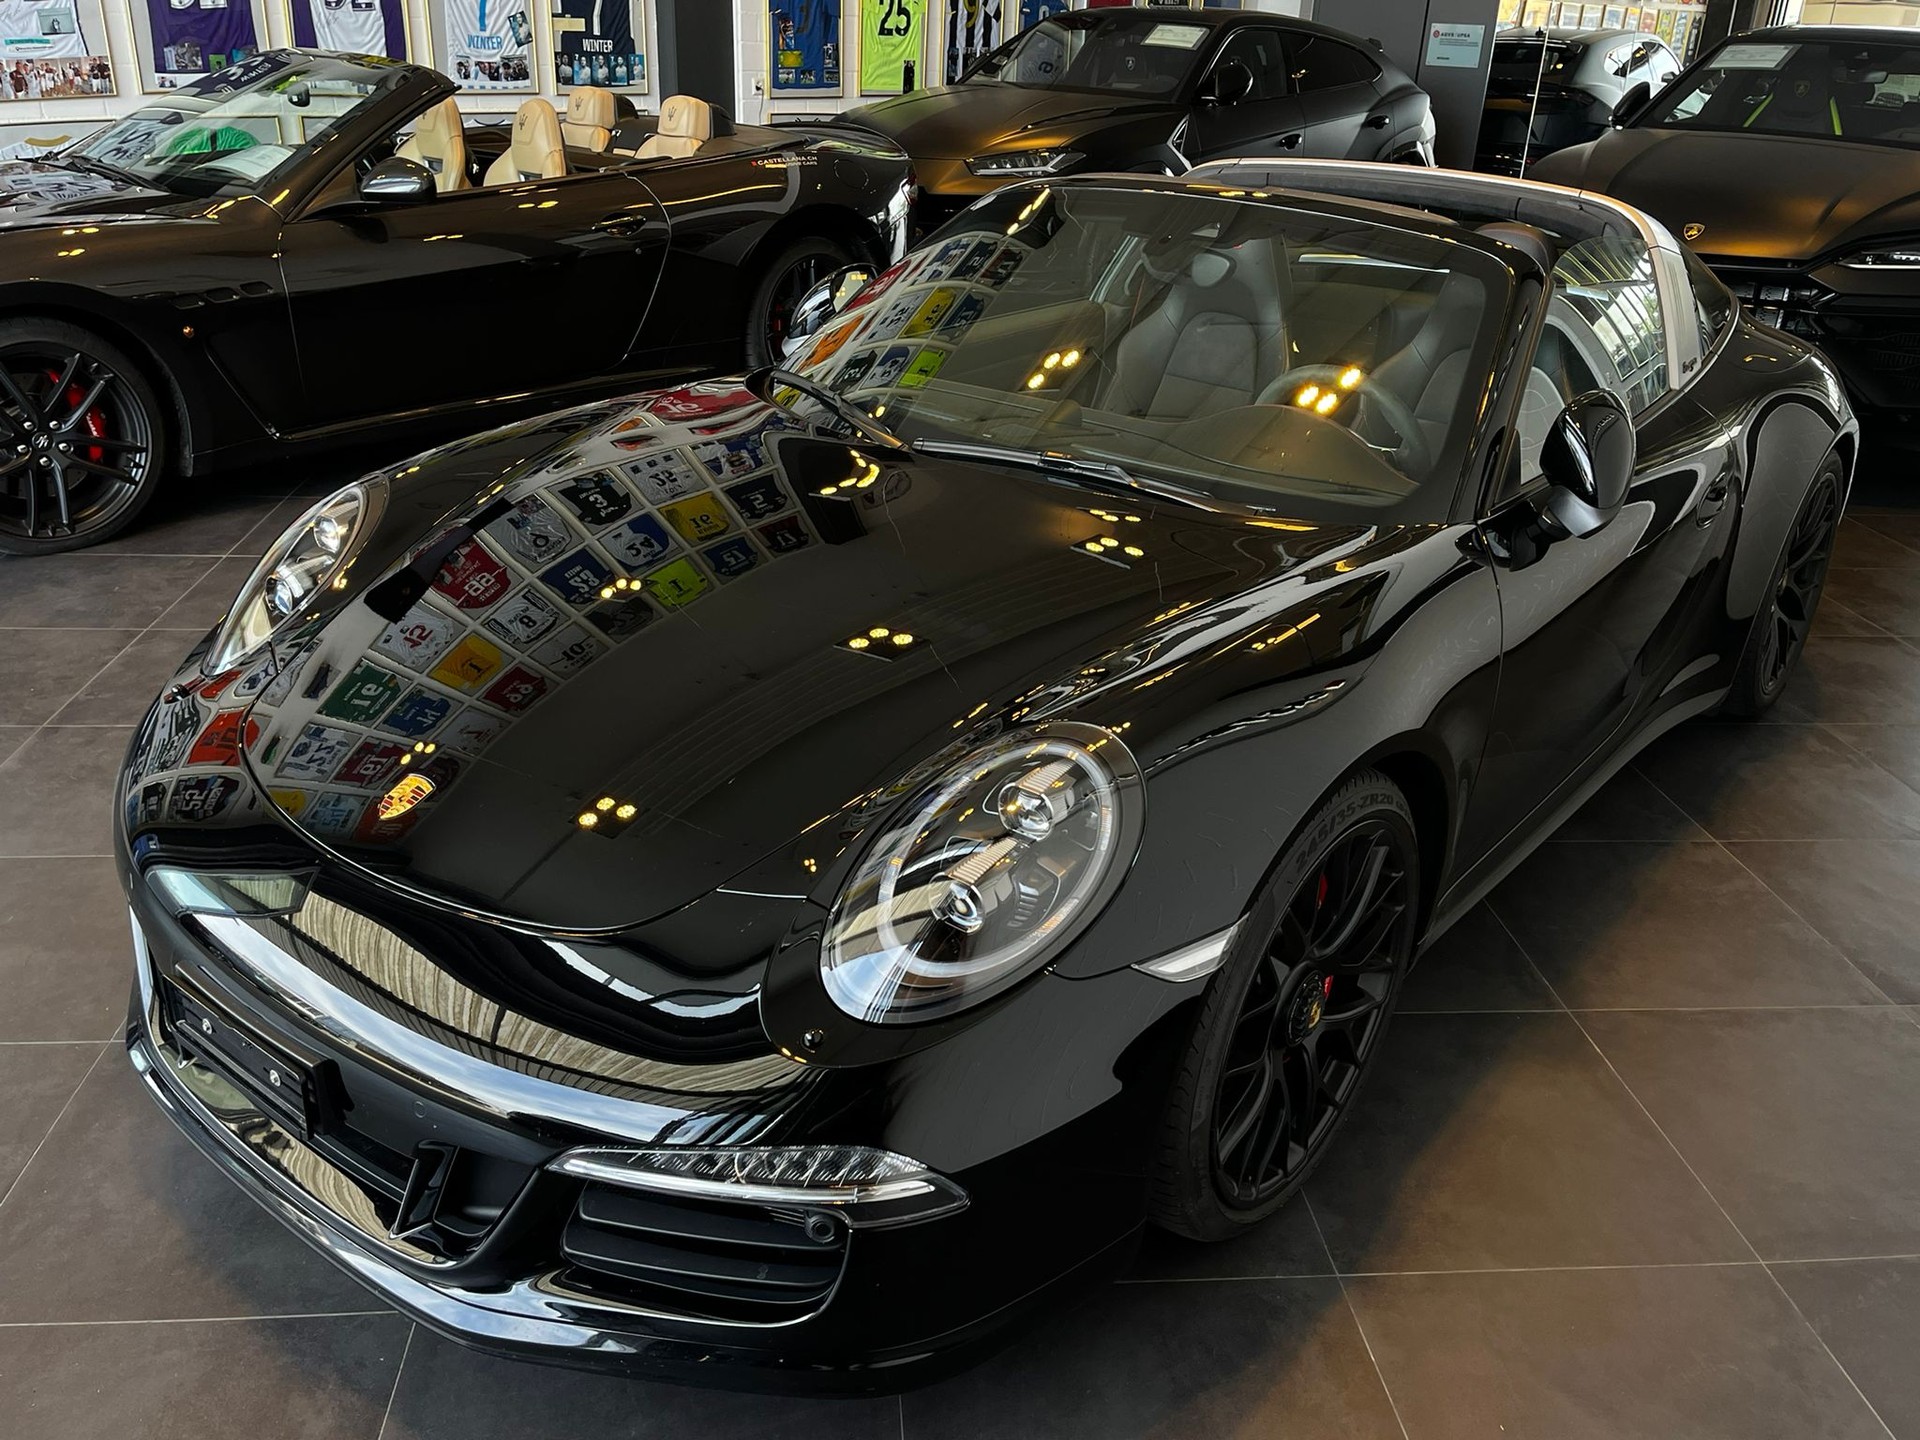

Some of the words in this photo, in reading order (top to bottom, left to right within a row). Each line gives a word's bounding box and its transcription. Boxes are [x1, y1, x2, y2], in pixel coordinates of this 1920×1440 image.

[878, 0, 910, 36] 25
[468, 34, 503, 50] WINTER
[582, 38, 614, 53] WINTER
